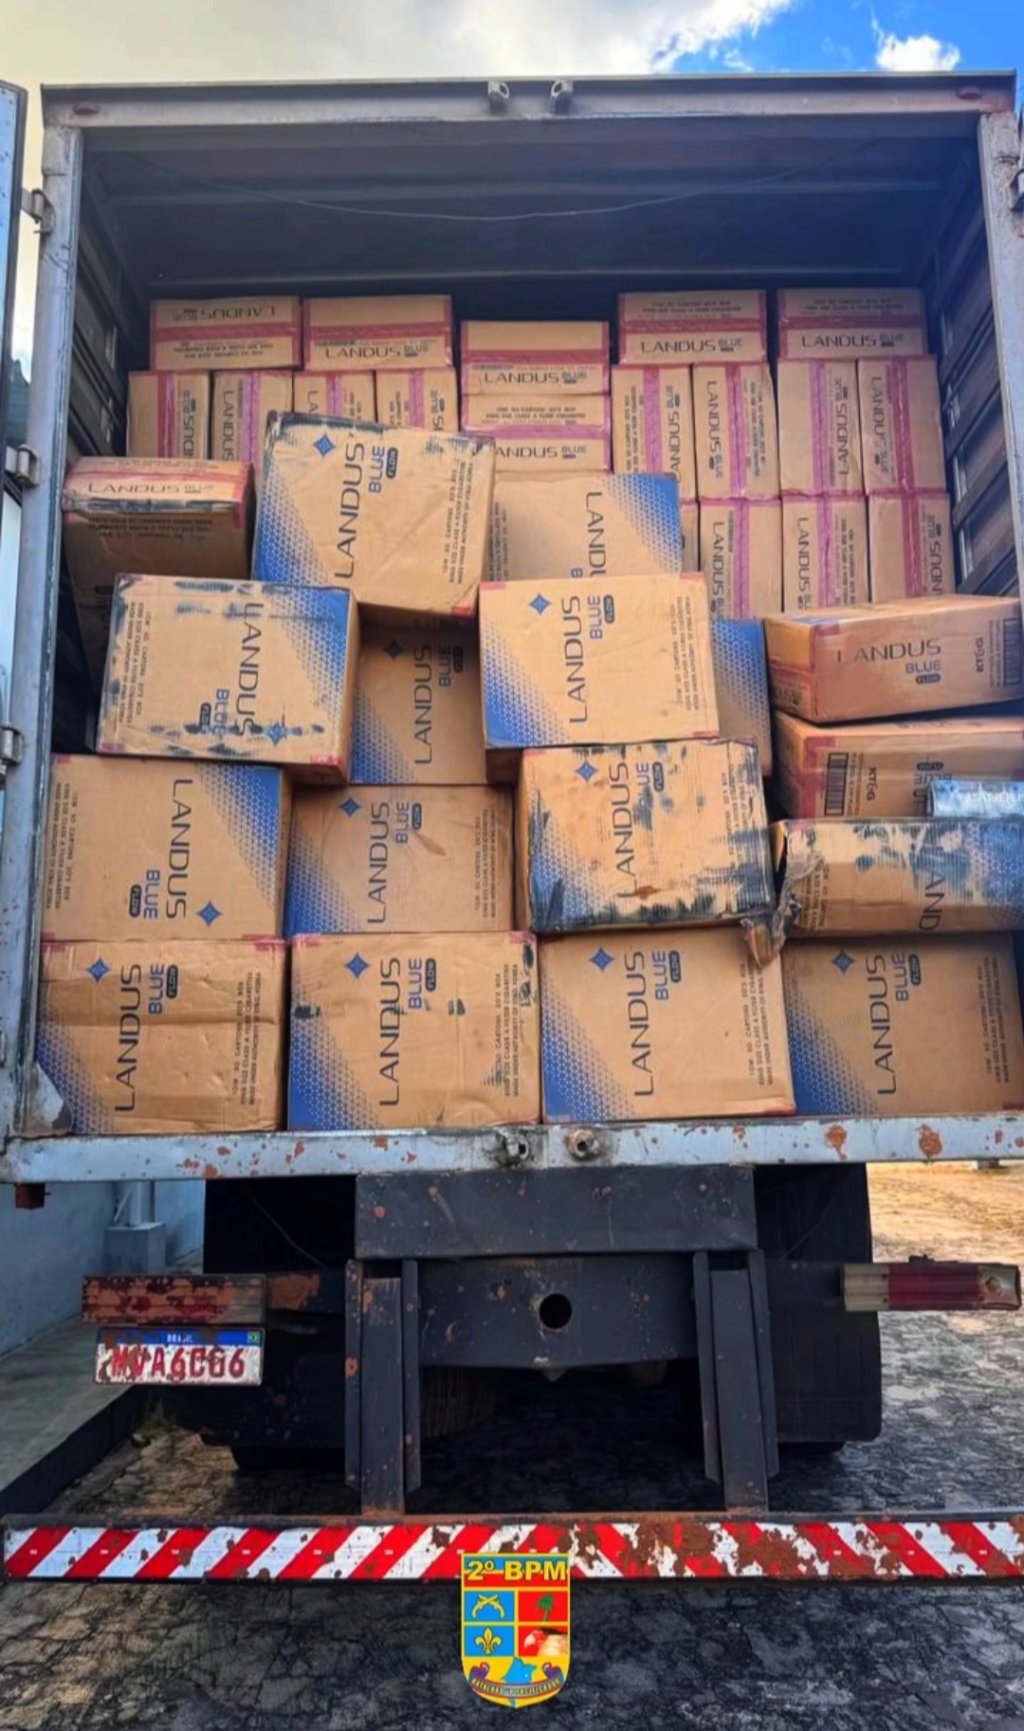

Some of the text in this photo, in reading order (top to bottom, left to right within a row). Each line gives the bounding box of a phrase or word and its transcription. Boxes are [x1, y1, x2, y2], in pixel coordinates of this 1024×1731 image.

[325, 345, 400, 359] LANDUS
[641, 341, 716, 353] LANDUS
[802, 335, 876, 347] LANDUS
[484, 372, 560, 384] LANDUS
[668, 411, 681, 472] ANDUS
[707, 381, 721, 453] LANDUS
[836, 403, 849, 475] LANDUS
[369, 445, 385, 493] BLUE
[495, 446, 558, 458] ANDUS
[88, 483, 180, 493] LANDUS
[334, 442, 364, 579] LANDUS
[587, 492, 606, 577] LAND
[712, 521, 725, 596] LANDUS
[798, 518, 811, 592] LANDUS
[930, 541, 943, 595] NDUS
[588, 596, 603, 640] BLUE
[236, 602, 264, 736] LANDUS
[561, 596, 588, 723] LANDUS
[905, 660, 942, 674] BLUE
[213, 689, 229, 736] BLUE
[414, 645, 432, 764] LANDUS
[166, 779, 193, 919] LANDUS
[396, 801, 409, 843] BLUE
[609, 762, 637, 898] LANDUS
[367, 802, 390, 924] LANDUS
[144, 870, 160, 919] BLUE
[148, 963, 164, 1015] BLUE
[408, 958, 423, 1009] BLUE
[426, 959, 436, 991] FLOW
[652, 950, 669, 1000] BLUE
[891, 951, 909, 1001] BLUE
[114, 964, 142, 1112] LANDUS
[379, 957, 400, 1106] LANDUS
[625, 951, 654, 1096] LANDUS
[866, 954, 897, 1095] LANDUS
